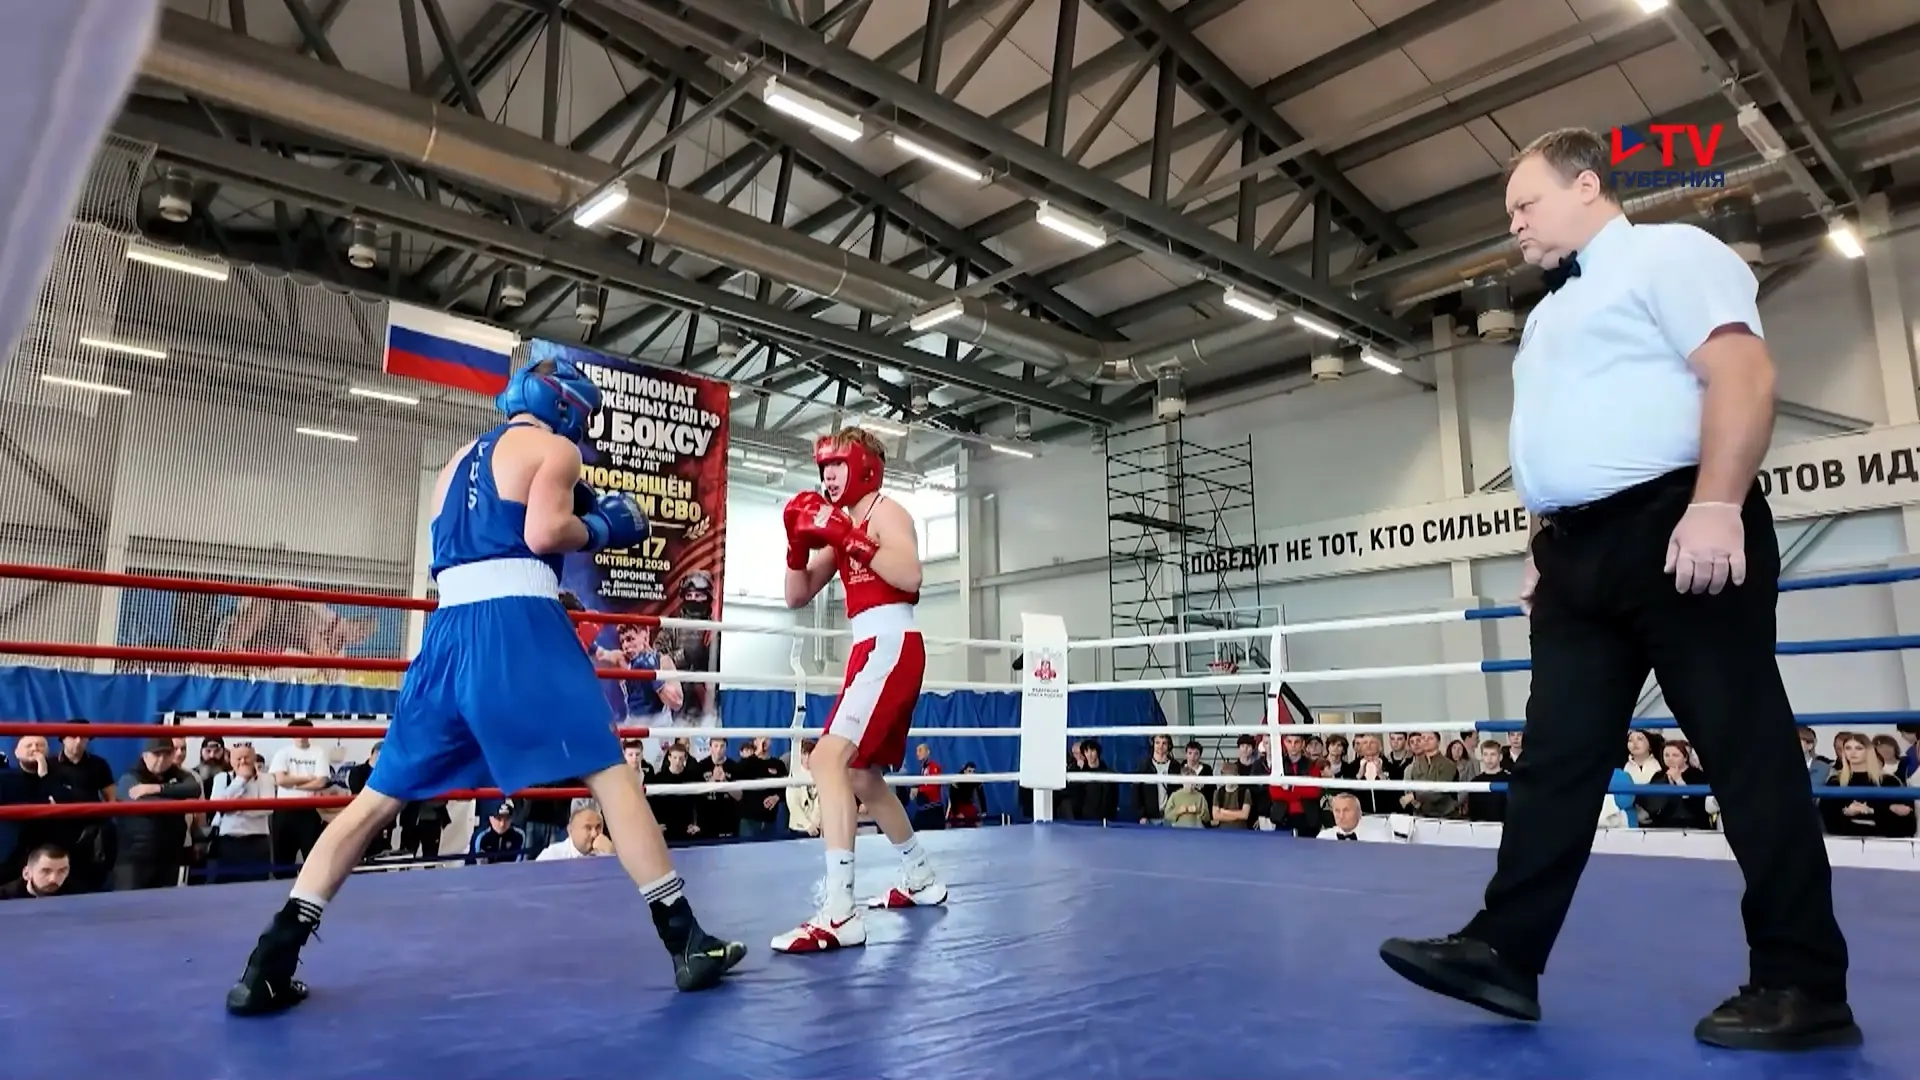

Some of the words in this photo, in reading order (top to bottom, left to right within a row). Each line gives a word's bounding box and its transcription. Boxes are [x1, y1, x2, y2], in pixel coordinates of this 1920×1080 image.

[669, 404, 698, 425] СИЛ
[701, 409, 721, 429] РФ
[611, 410, 713, 457] БОКСУ
[596, 439, 631, 457] СРЕДИ
[631, 445, 676, 464] МУЖЧИН
[642, 460, 661, 473] ЛЕТ
[580, 464, 692, 500] ПОСВЯЩЁН
[660, 497, 703, 523] СВО
[1286, 537, 1313, 563] НЕ
[1318, 530, 1364, 558] ТОТ,
[1369, 523, 1416, 551] КТО
[1422, 506, 1529, 543] СИЛЬНЕ
[1857, 446, 1920, 485] ИД
[594, 552, 643, 569] ОКТЯБРЯ
[610, 568, 656, 583] ВОРОНЕЖ
